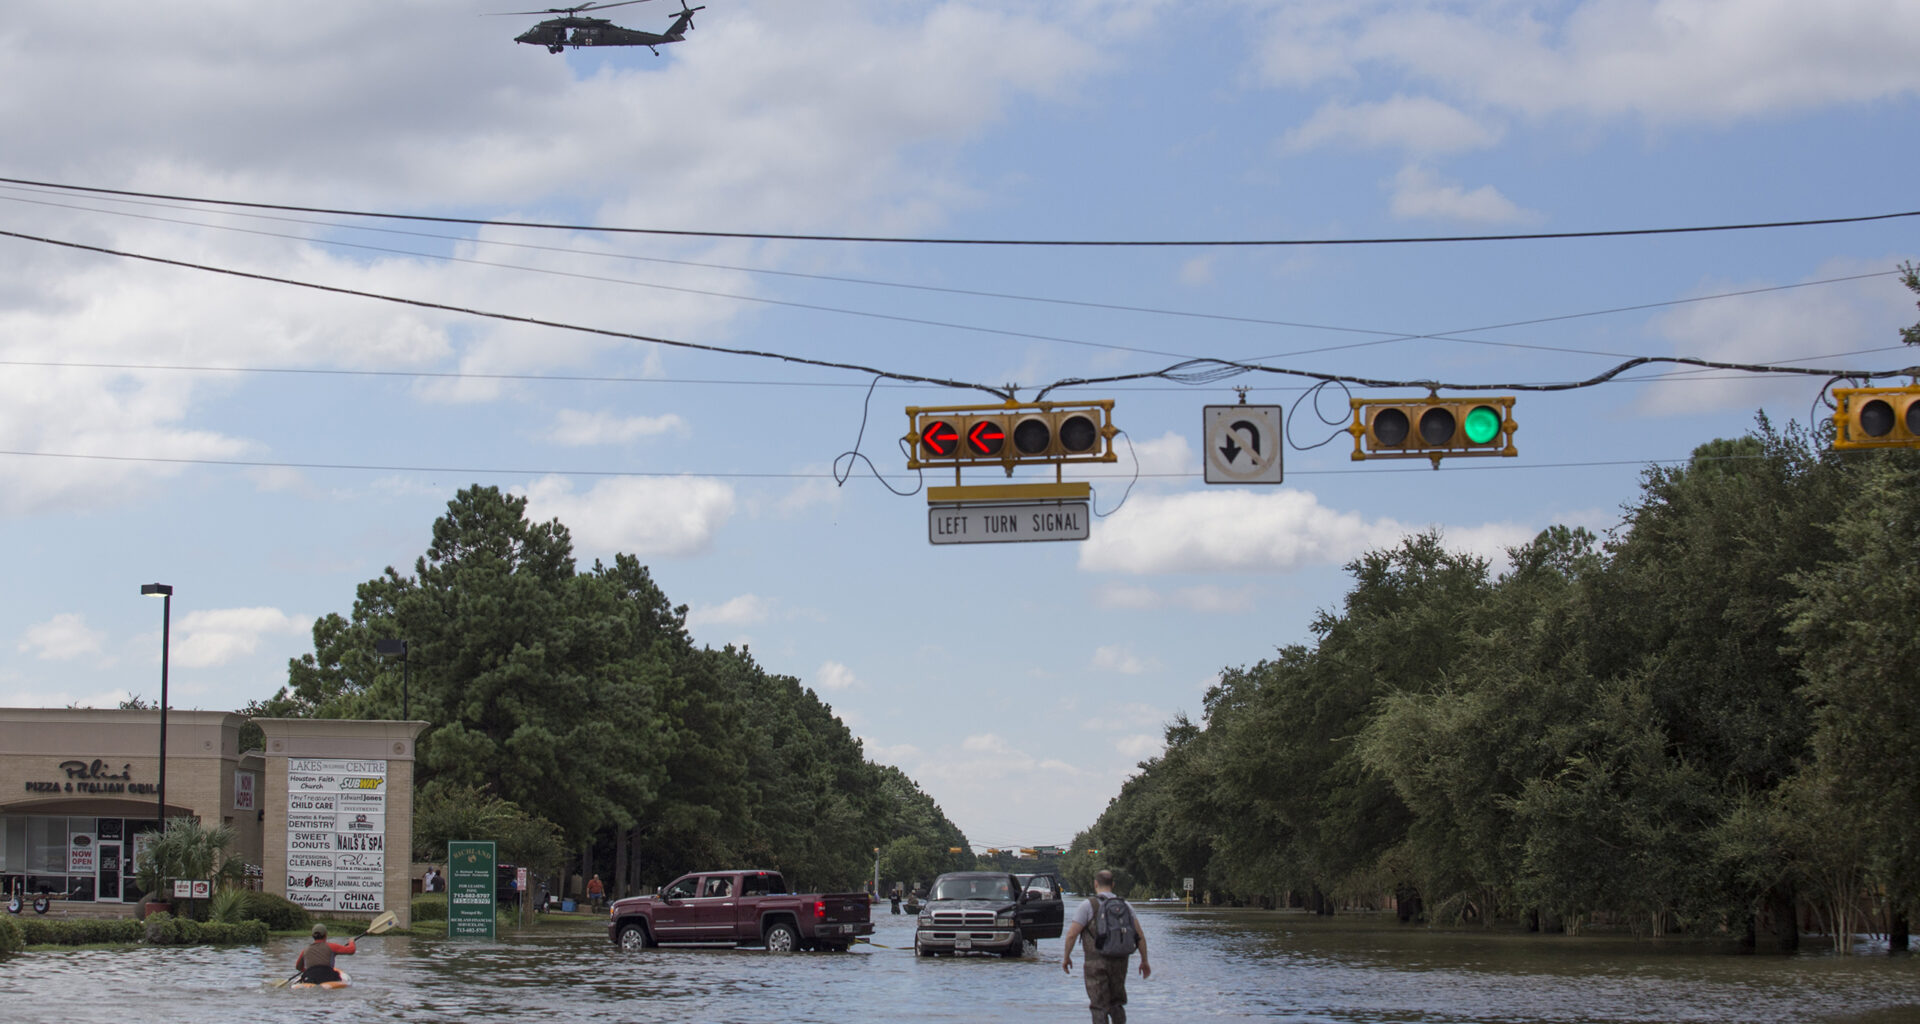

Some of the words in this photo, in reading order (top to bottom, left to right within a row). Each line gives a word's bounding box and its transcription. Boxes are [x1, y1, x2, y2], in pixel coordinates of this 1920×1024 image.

[938, 516, 968, 535] LEFT
[984, 515, 1017, 533] TURN
[1032, 513, 1080, 532] SIGNAL
[290, 760, 322, 771] LAKES
[346, 762, 385, 772] CENTRE
[26, 782, 61, 793] PIZZA
[65, 782, 73, 793] &
[77, 782, 124, 793] ITALIAN
[241, 776, 252, 790] NOW
[340, 776, 384, 790] SUBWAY
[338, 834, 359, 850] NAILS
[361, 838, 366, 850] &
[369, 835, 383, 850] SPA
[288, 876, 304, 887] DARE
[314, 876, 334, 887] REPAIR
[339, 902, 380, 910] VILLAGE
